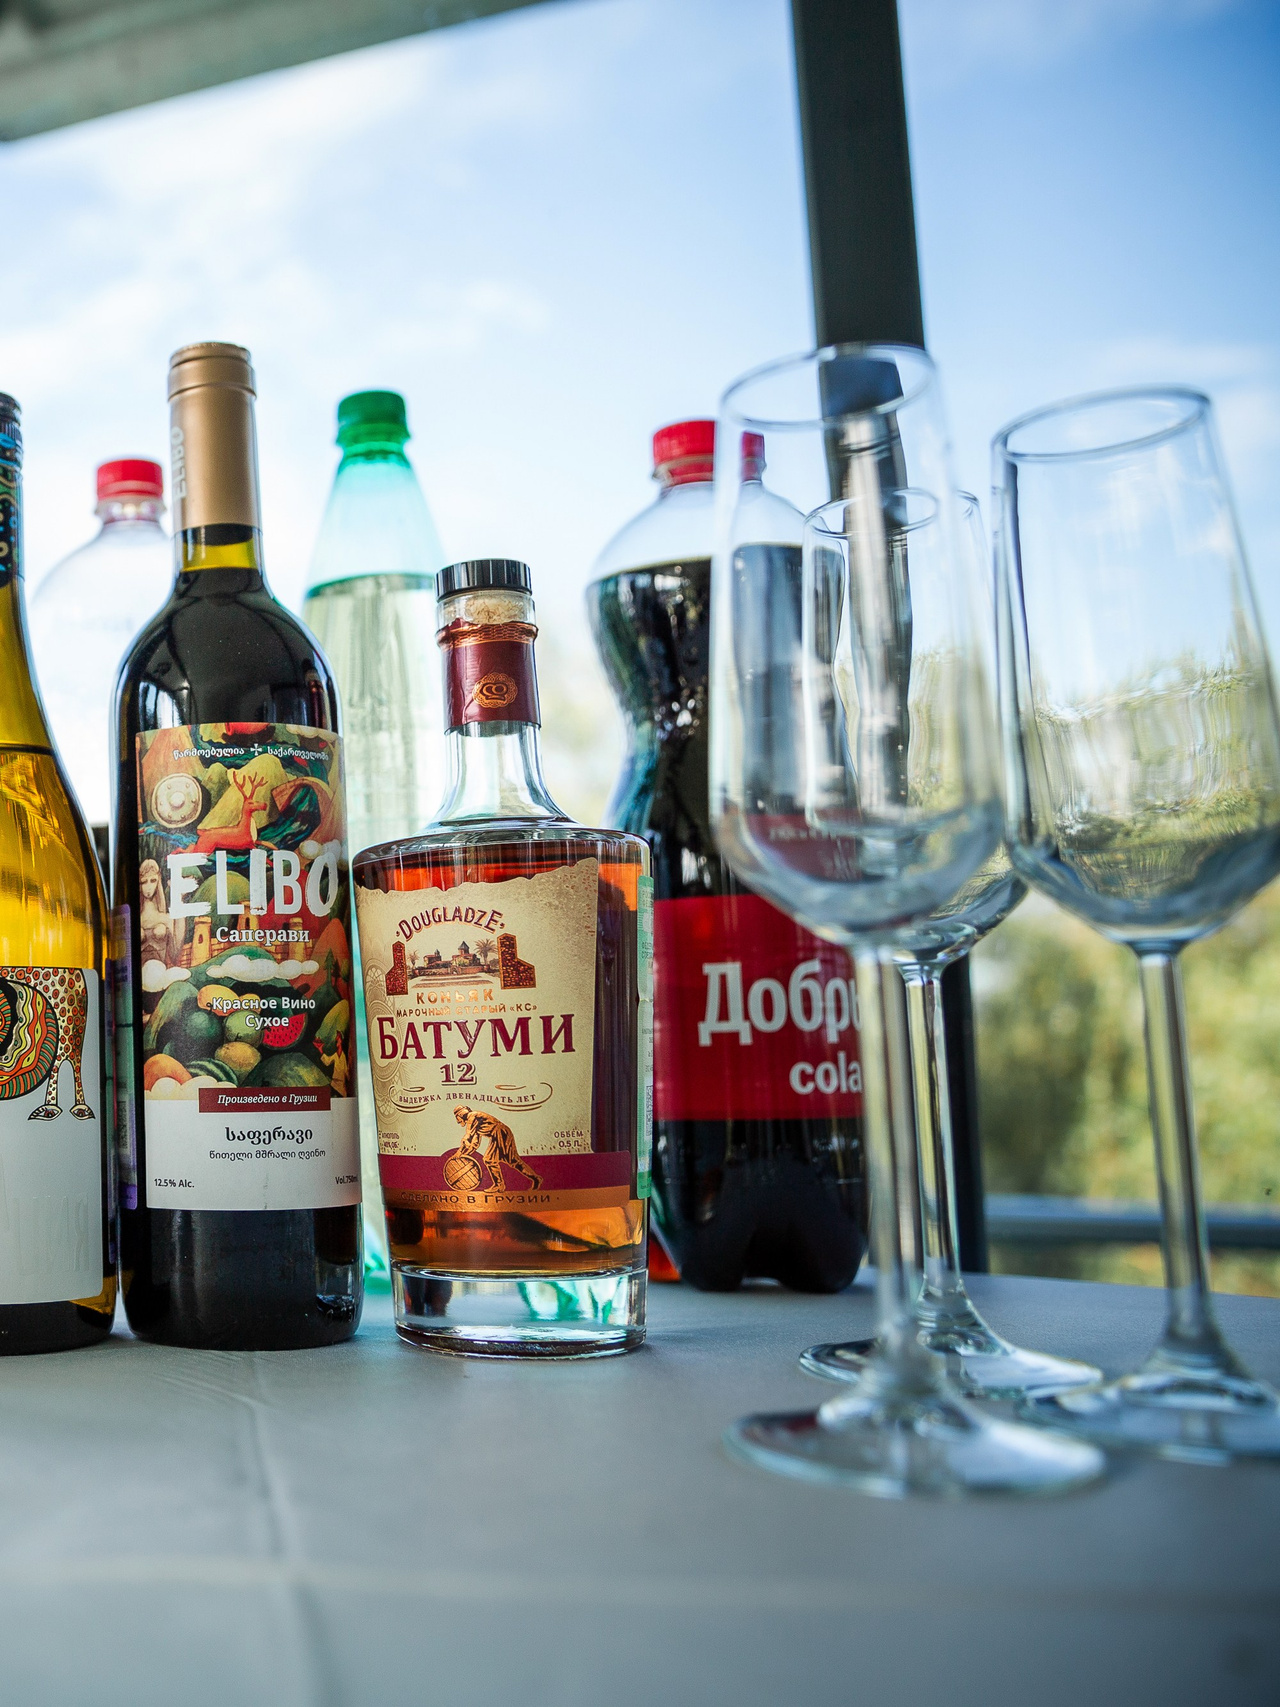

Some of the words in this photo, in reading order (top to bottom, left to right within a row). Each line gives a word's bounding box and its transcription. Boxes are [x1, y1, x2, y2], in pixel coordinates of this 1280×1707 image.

[170, 425, 187, 502] ELIBO
[166, 849, 339, 917] ELIBO
[398, 905, 504, 942] DOUGLADZE
[216, 926, 310, 947] Саперави
[212, 997, 277, 1014] Красное
[281, 996, 316, 1010] Вино
[416, 989, 495, 1005] КОНЬЯК
[396, 1006, 451, 1018] МАРОЧНЫЙ
[455, 1003, 507, 1015] СТАРЫЙ
[245, 1015, 289, 1029] Сухое
[376, 1014, 576, 1060] БАТУМИ
[440, 1063, 477, 1086] 12
[789, 1051, 862, 1094] cola
[217, 1094, 280, 1106] Произведено
[281, 1095, 287, 1103] в
[289, 1094, 318, 1105] Грузии
[399, 1094, 442, 1104] ВЫДЕРЖКА
[445, 1092, 513, 1104] ДВЕНАДЦАТЬ
[516, 1094, 537, 1103] ЛЕТ
[225, 1126, 313, 1145] საფერავი
[209, 1150, 253, 1161] წითელი
[255, 1150, 296, 1160] მშრალი
[298, 1148, 326, 1160] ღვინო
[178, 1179, 195, 1188] Alc.
[401, 1192, 459, 1204] СДЕЛАНО
